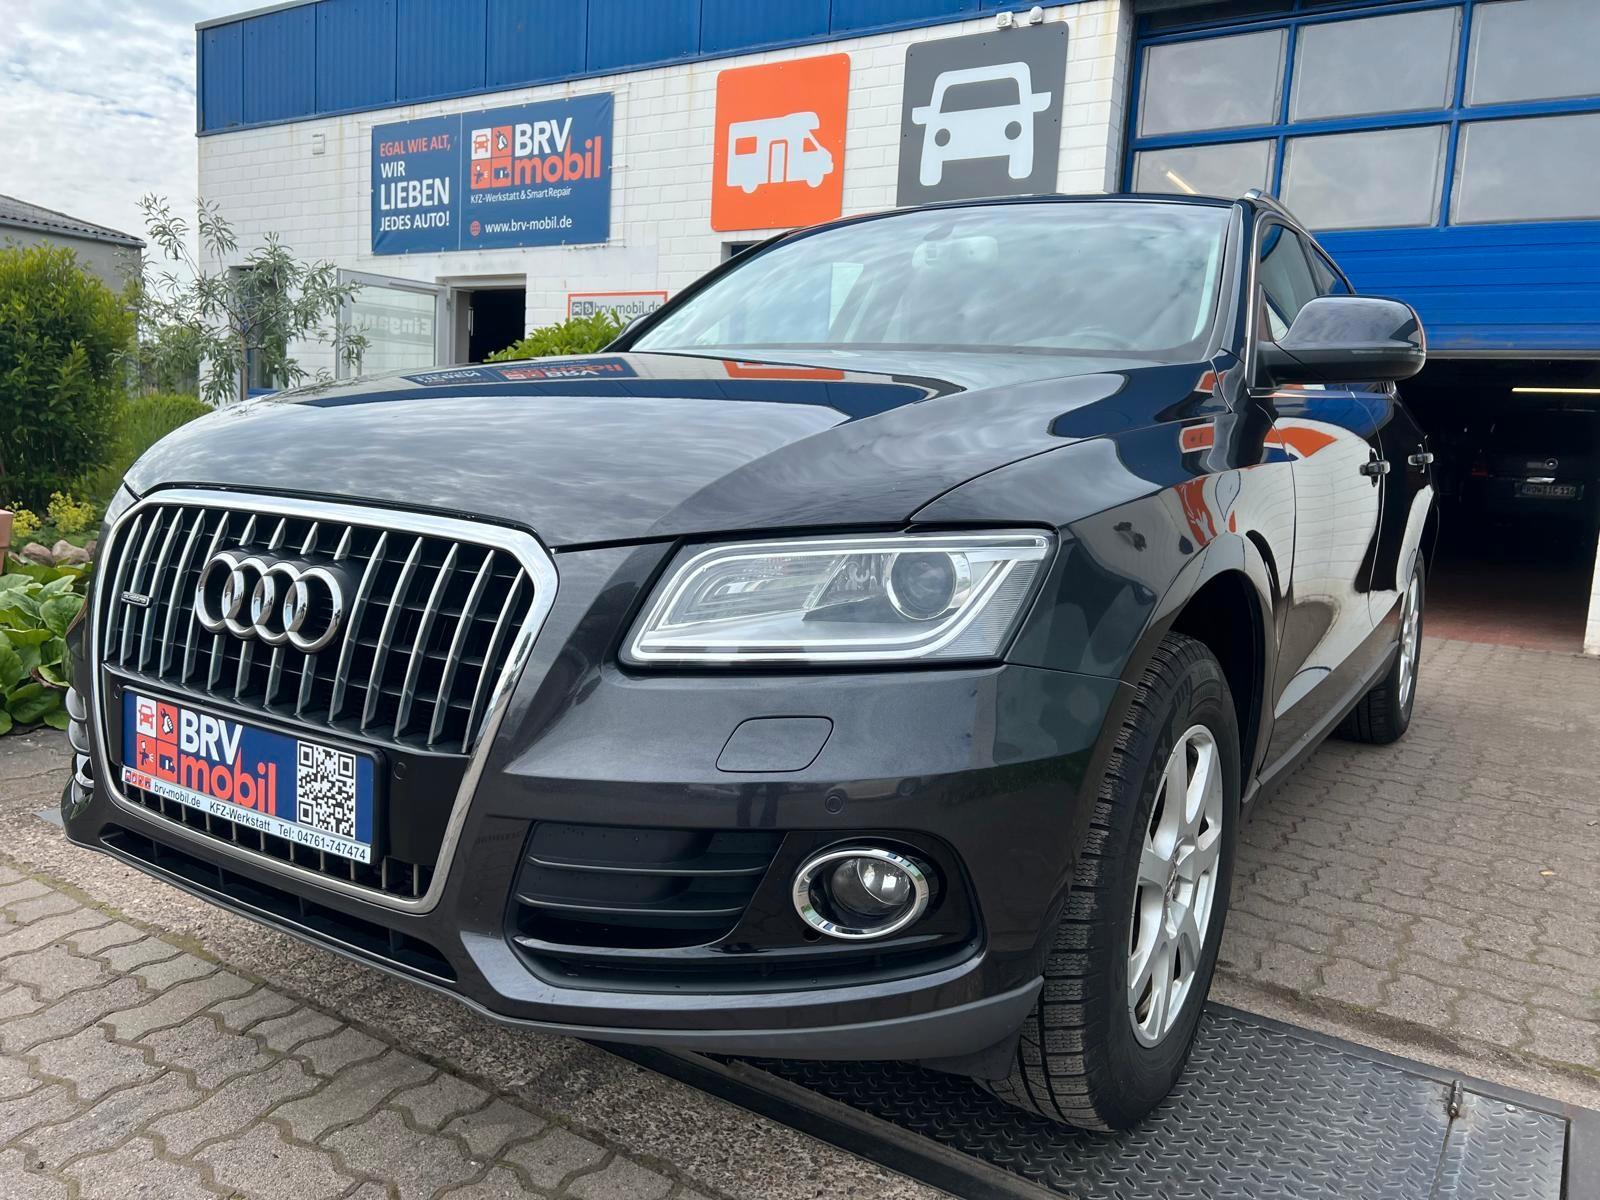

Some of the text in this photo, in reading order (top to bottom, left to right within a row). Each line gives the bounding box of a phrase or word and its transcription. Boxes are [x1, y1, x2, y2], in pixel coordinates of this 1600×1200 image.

[380, 134, 451, 157] EGAL WIE ALT,
[515, 117, 573, 157] BRV
[380, 160, 406, 178] WIR
[514, 134, 602, 186] mobil
[380, 176, 450, 211] LIEBEN
[521, 190, 526, 200] &
[380, 210, 450, 232] JEDES AUTO!
[485, 216, 573, 234] www.brv-mobil.de
[595, 301, 661, 316] brvmobil.d
[180, 708, 244, 766] BRV
[180, 748, 276, 817] mobil
[154, 782, 366, 861] brv-mobil.de KFZ-Werkstatt Tel: 04761-747474
